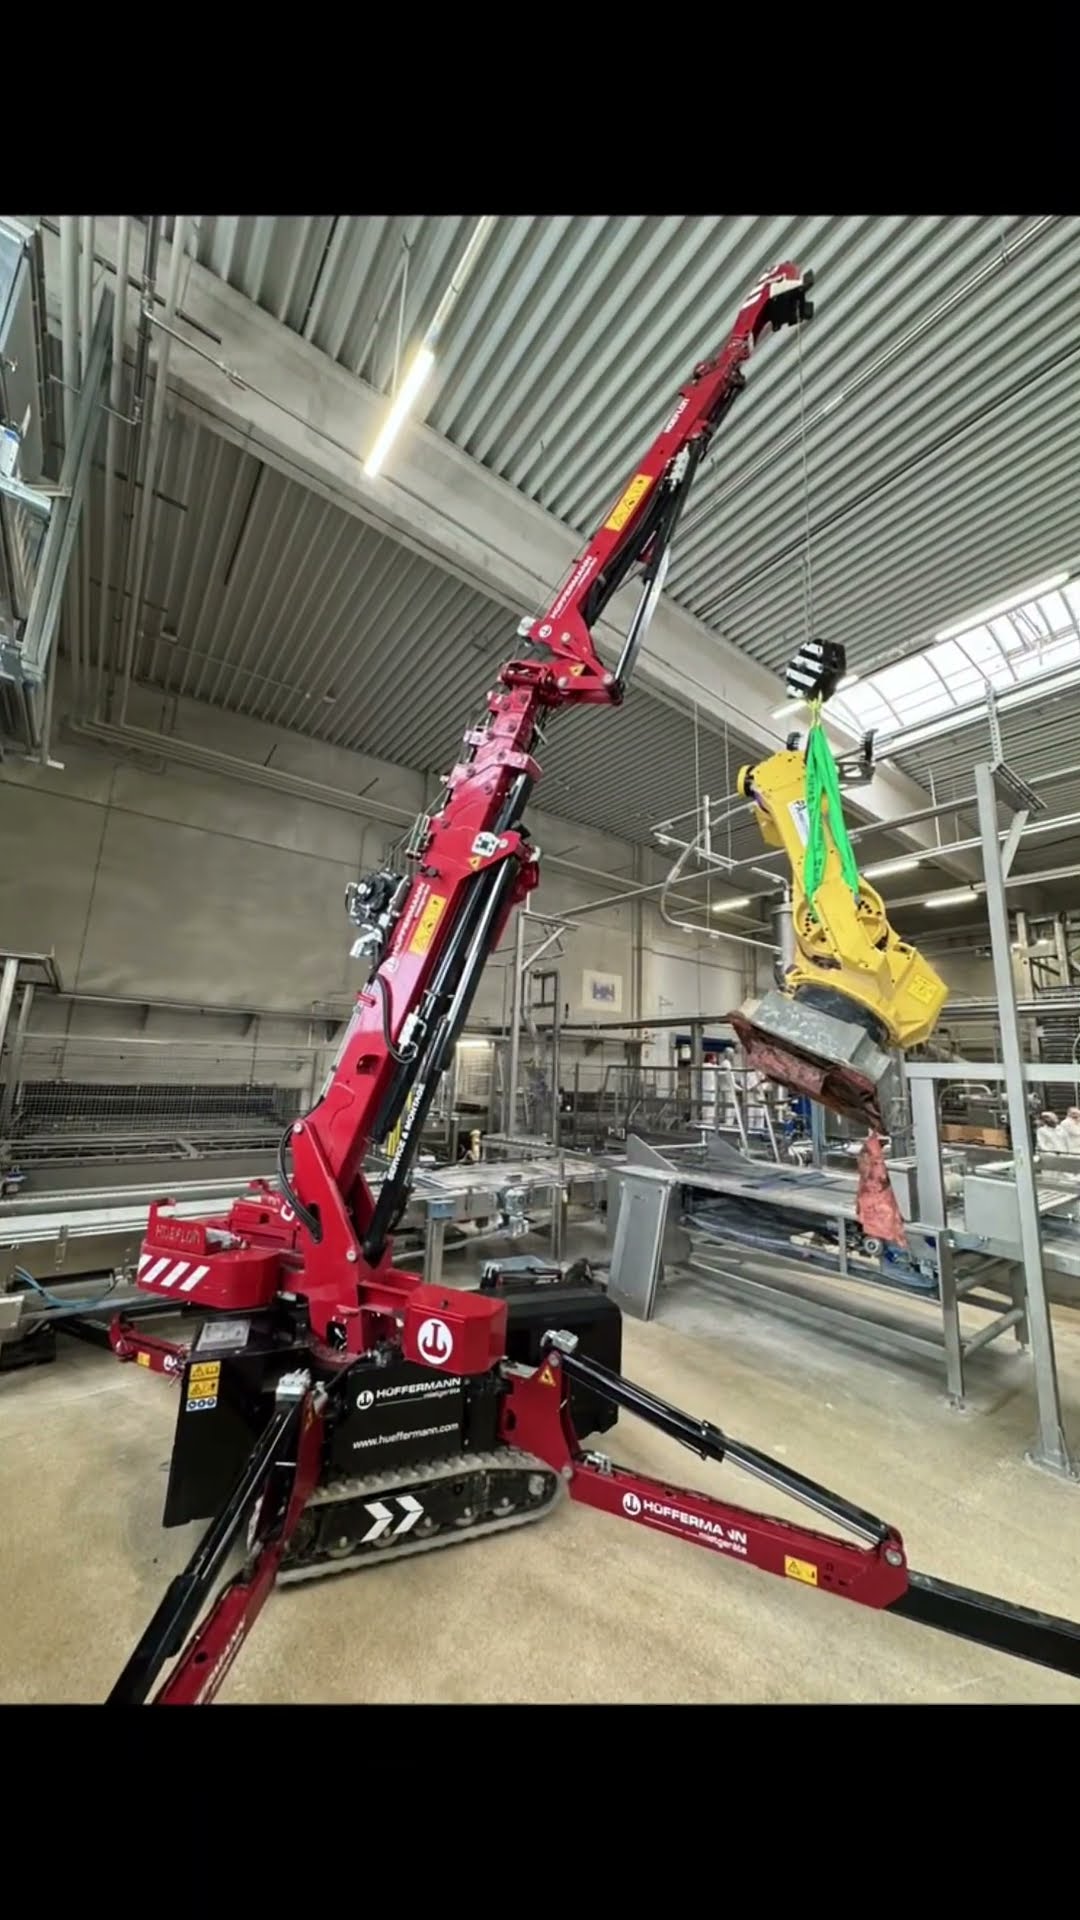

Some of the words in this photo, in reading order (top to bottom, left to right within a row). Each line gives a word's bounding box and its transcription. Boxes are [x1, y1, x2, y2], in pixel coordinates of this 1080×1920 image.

[387, 1138, 407, 1181] SERVICE
[404, 1083, 426, 1131] MONTAGE
[352, 1422, 459, 1449] www.hueffermann.com
